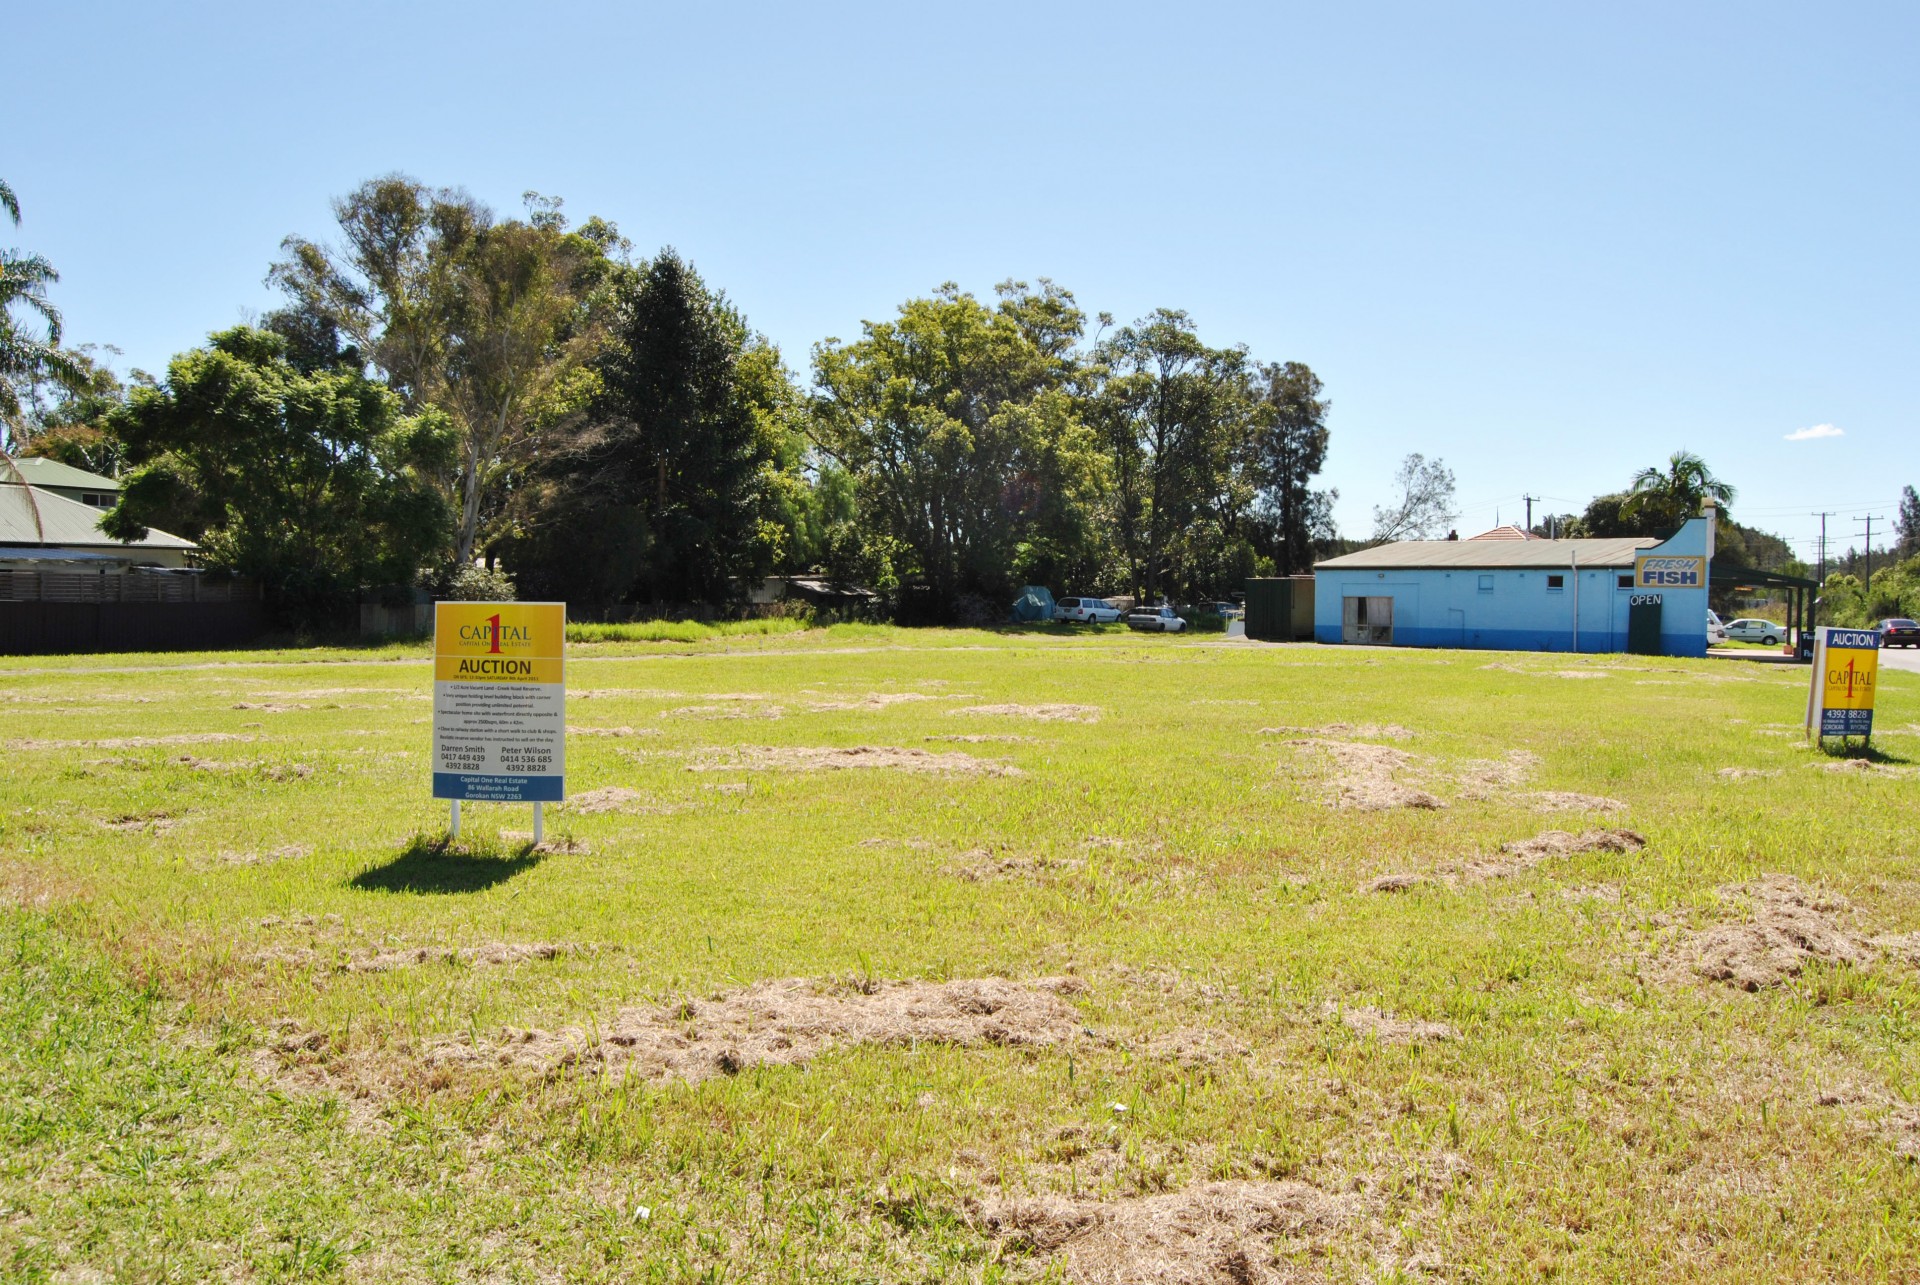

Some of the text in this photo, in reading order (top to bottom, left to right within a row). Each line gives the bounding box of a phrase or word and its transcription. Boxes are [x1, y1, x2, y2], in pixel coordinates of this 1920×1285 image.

[1643, 558, 1698, 570] FRESH
[1643, 571, 1697, 585] FISH
[1630, 594, 1661, 606] OPEN
[459, 625, 532, 641] CAPITAL
[1832, 633, 1874, 647] AUCTION
[459, 659, 531, 674] AUCTION
[1827, 709, 1867, 719] 4392 8828
[441, 744, 485, 753] Darren Smith
[501, 746, 522, 754] Peter
[441, 753, 486, 762] 0417 449 439
[500, 755, 552, 763] 0414 536 685
[445, 762, 480, 771] 4392 8828
[506, 764, 547, 772] 4392 8828
[476, 784, 502, 792] Wallarah
